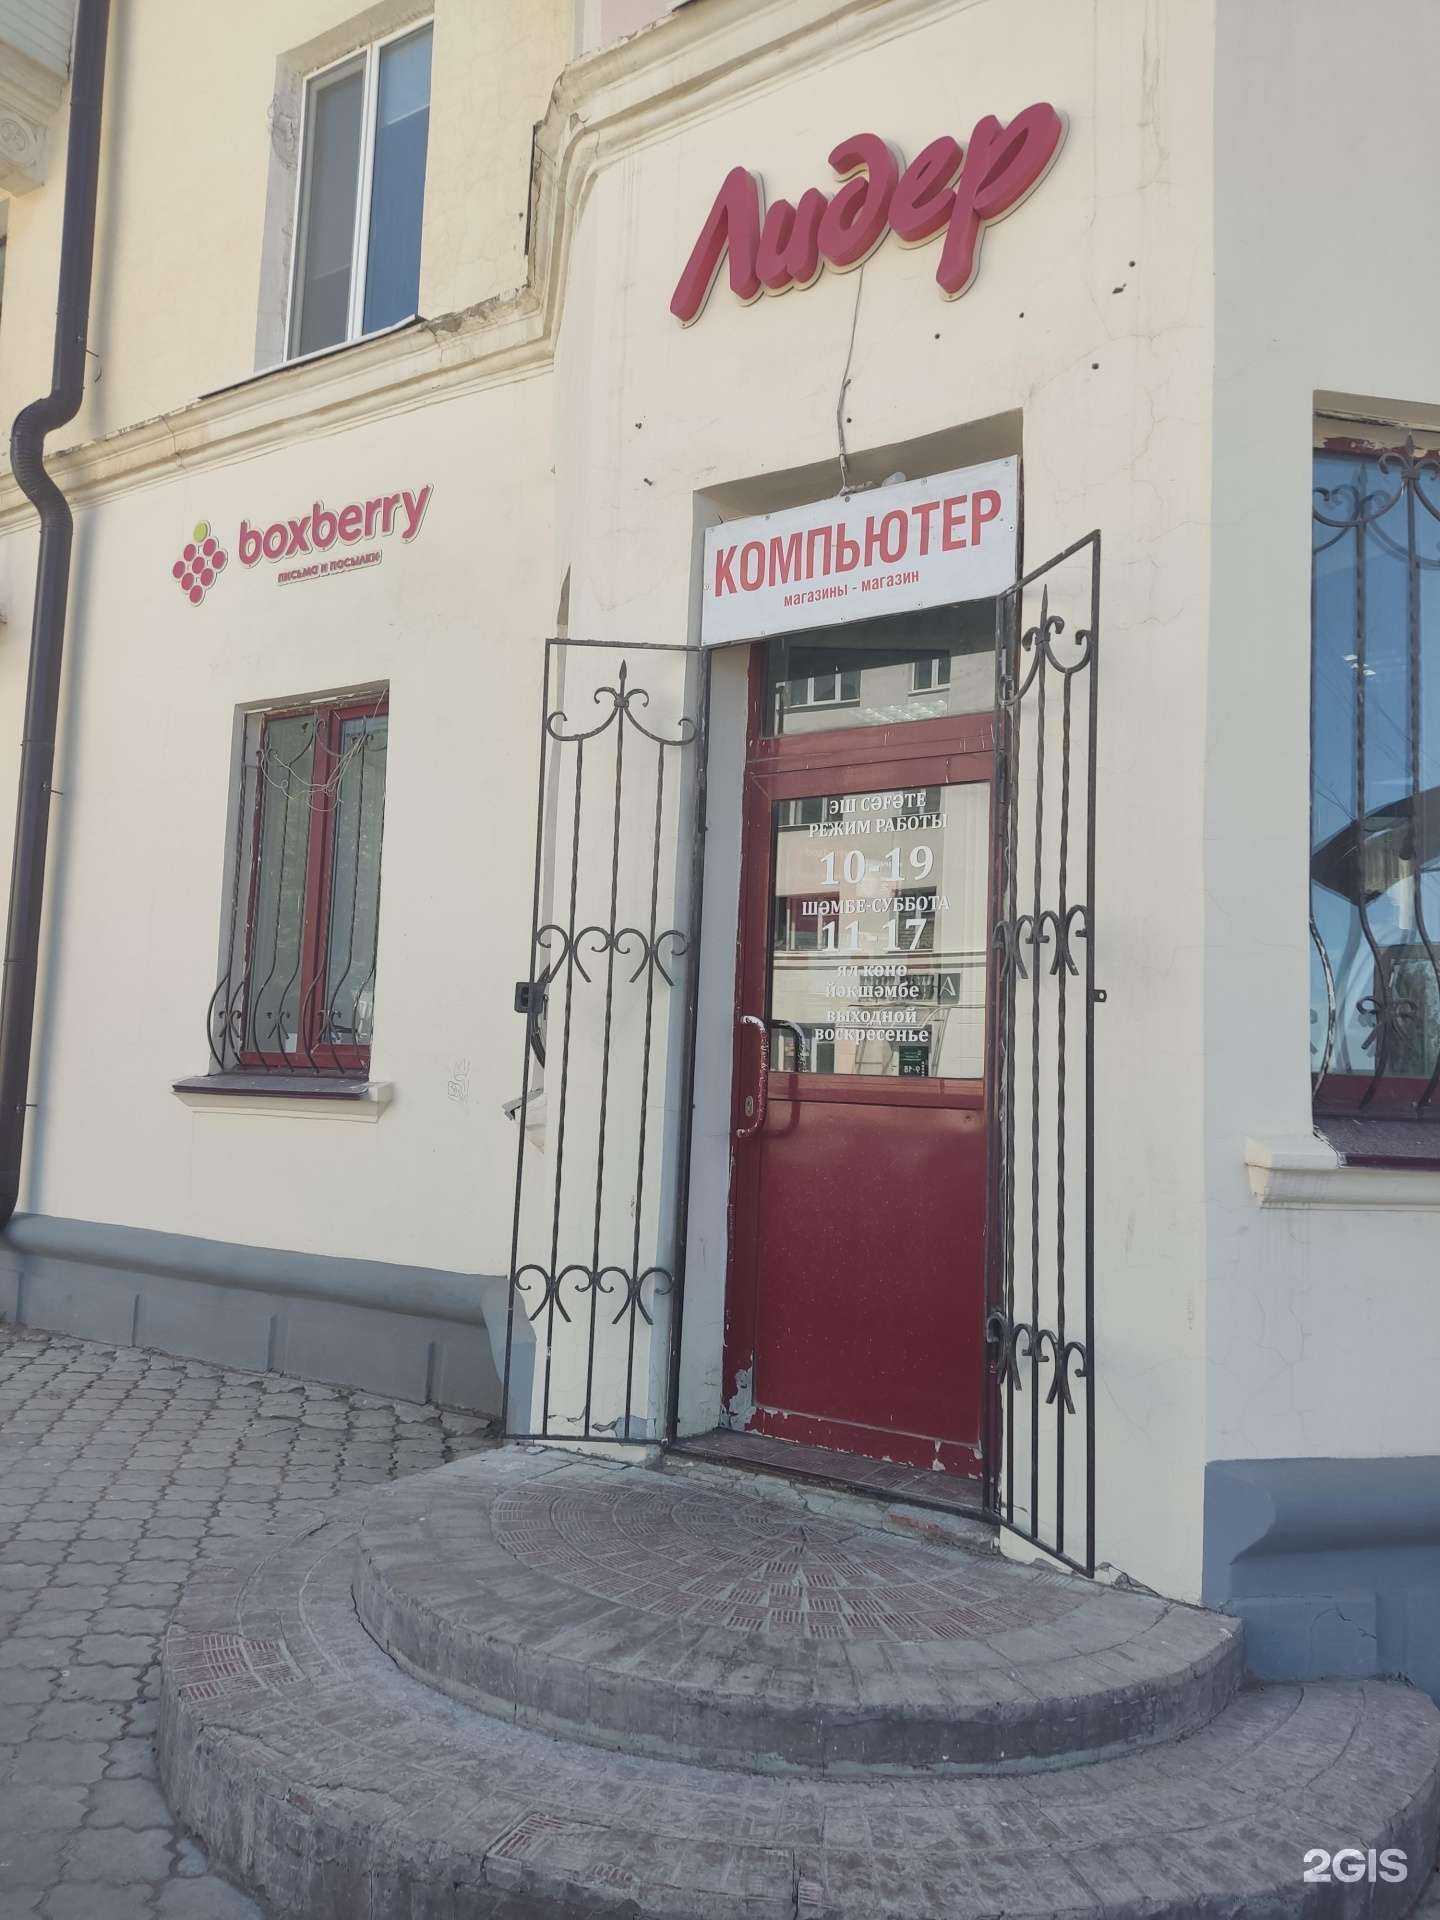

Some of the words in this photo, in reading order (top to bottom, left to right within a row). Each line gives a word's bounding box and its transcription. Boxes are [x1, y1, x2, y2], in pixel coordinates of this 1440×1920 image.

[669, 102, 1064, 325] Лидер
[238, 483, 433, 566] boxberry
[714, 489, 1002, 598] КОМПЬЮТЕР
[784, 583, 849, 608] магазины
[861, 570, 920, 593] магазин
[829, 798, 857, 815] ЭШ
[807, 819, 873, 838] РЕЖИМ
[875, 813, 948, 834] РАБОТЫ
[826, 1006, 917, 1025] выходной
[814, 1027, 929, 1046] воскресенье
